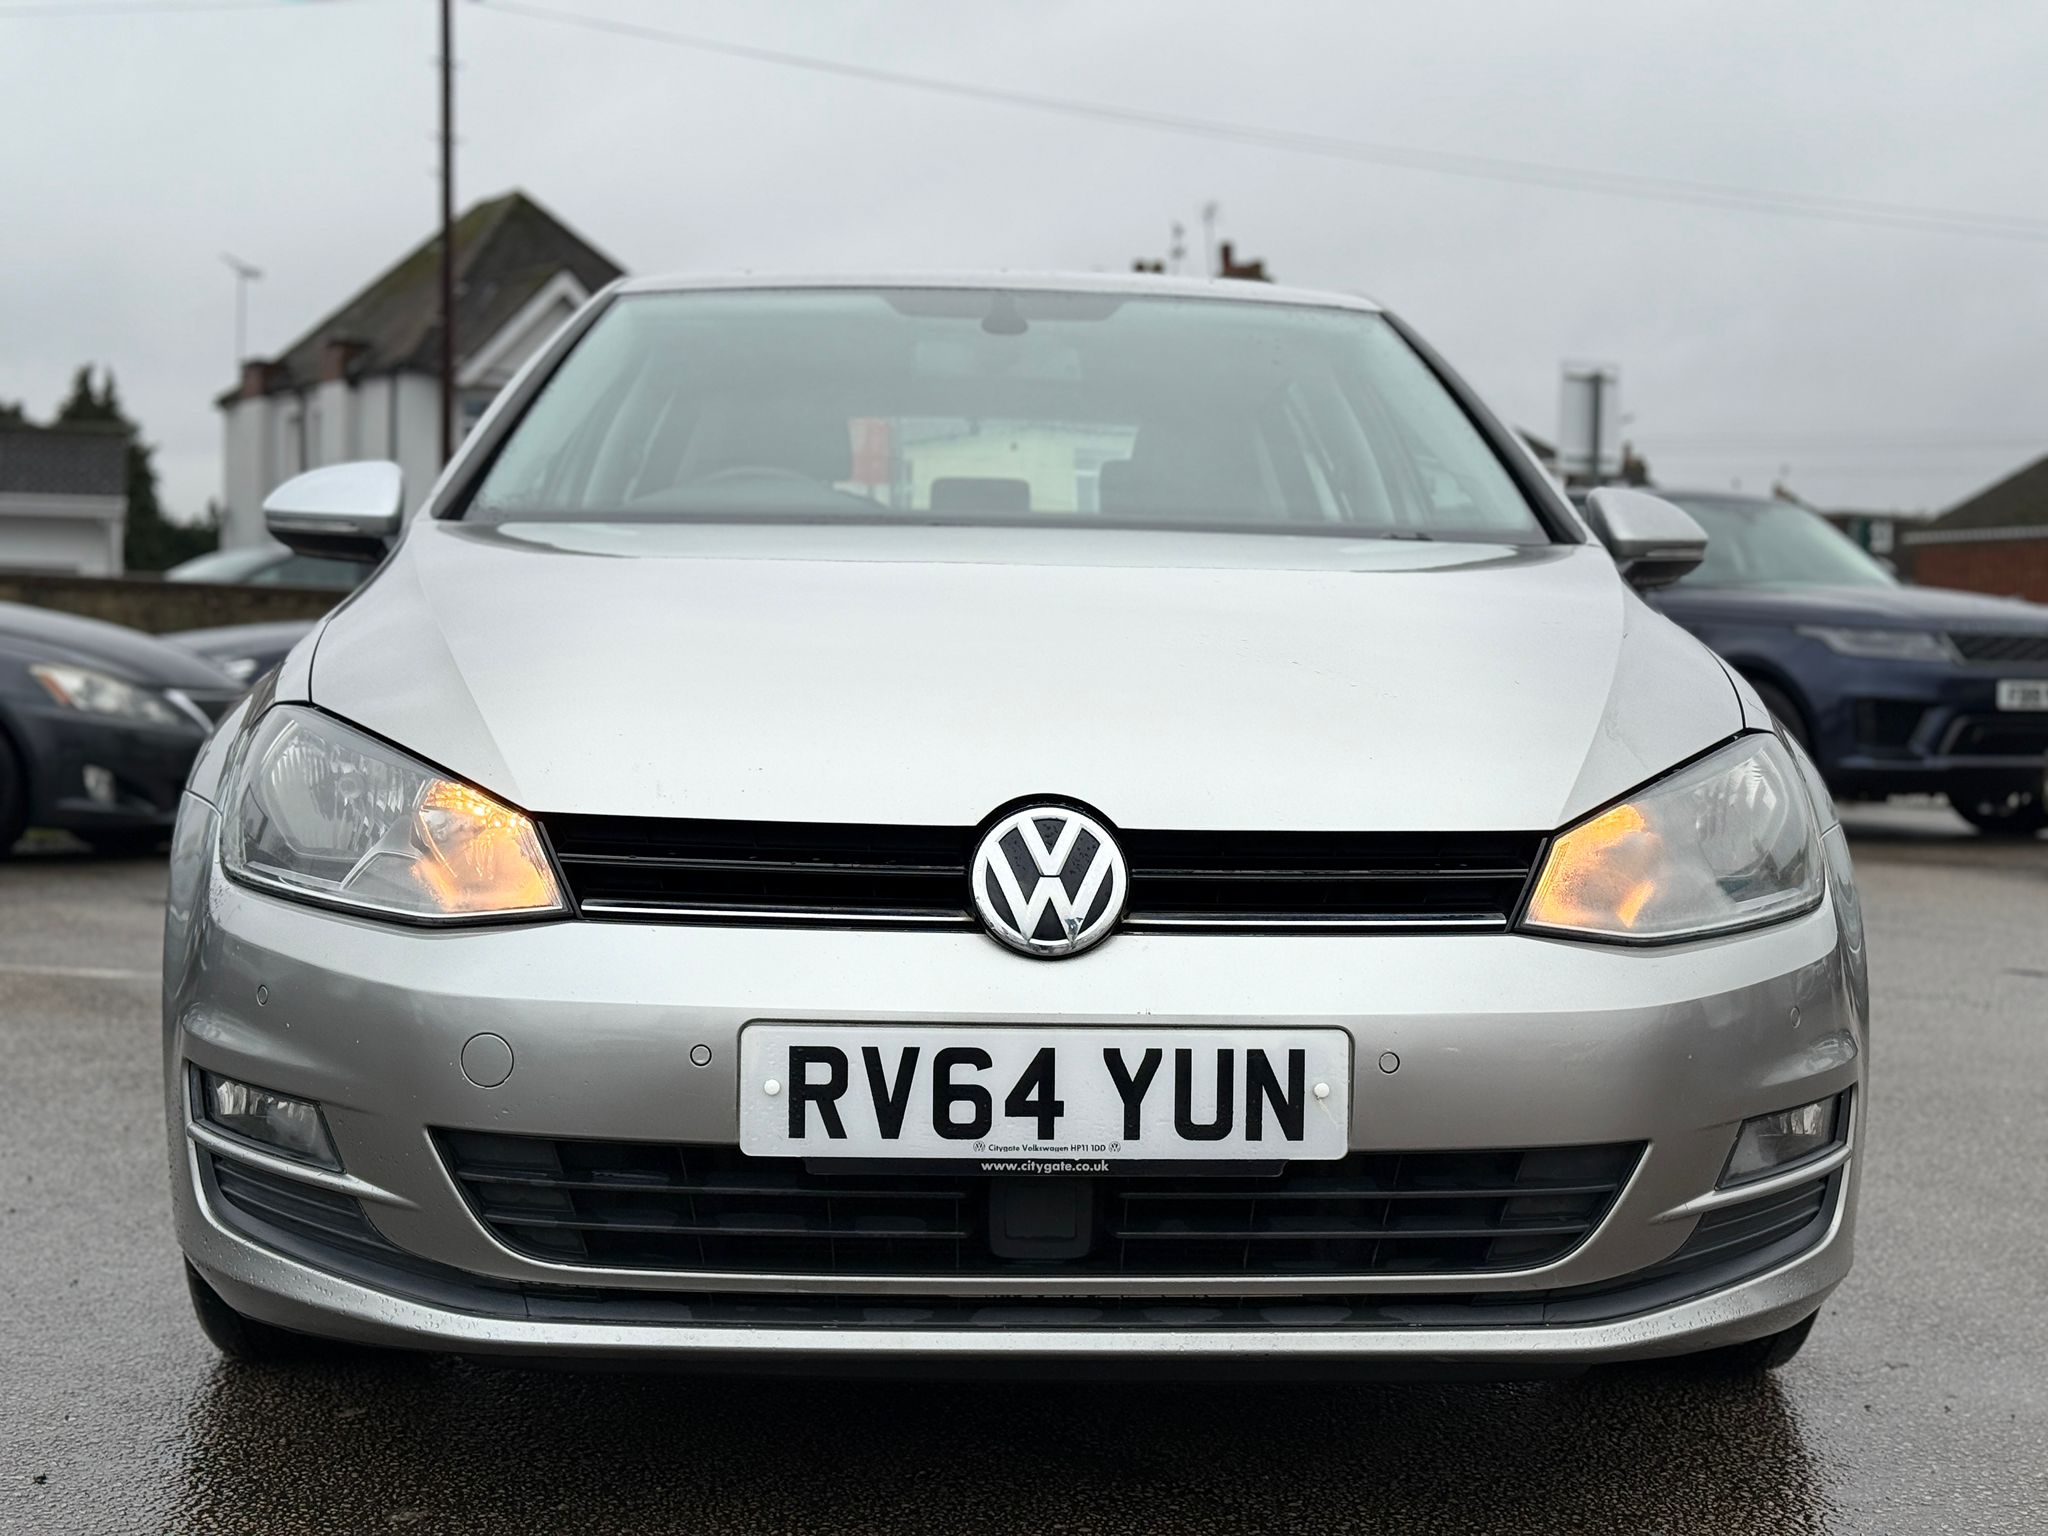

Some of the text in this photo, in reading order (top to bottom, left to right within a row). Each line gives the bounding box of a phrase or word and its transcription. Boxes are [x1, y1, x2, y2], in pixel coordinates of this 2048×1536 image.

[788, 1045, 1306, 1142] RV64 YUN
[988, 1144, 1020, 1153] Citygate
[1022, 1144, 1069, 1153] Volkswagen
[1071, 1144, 1089, 1152] HP11
[981, 1160, 1109, 1173] www.citygate.co.uk
